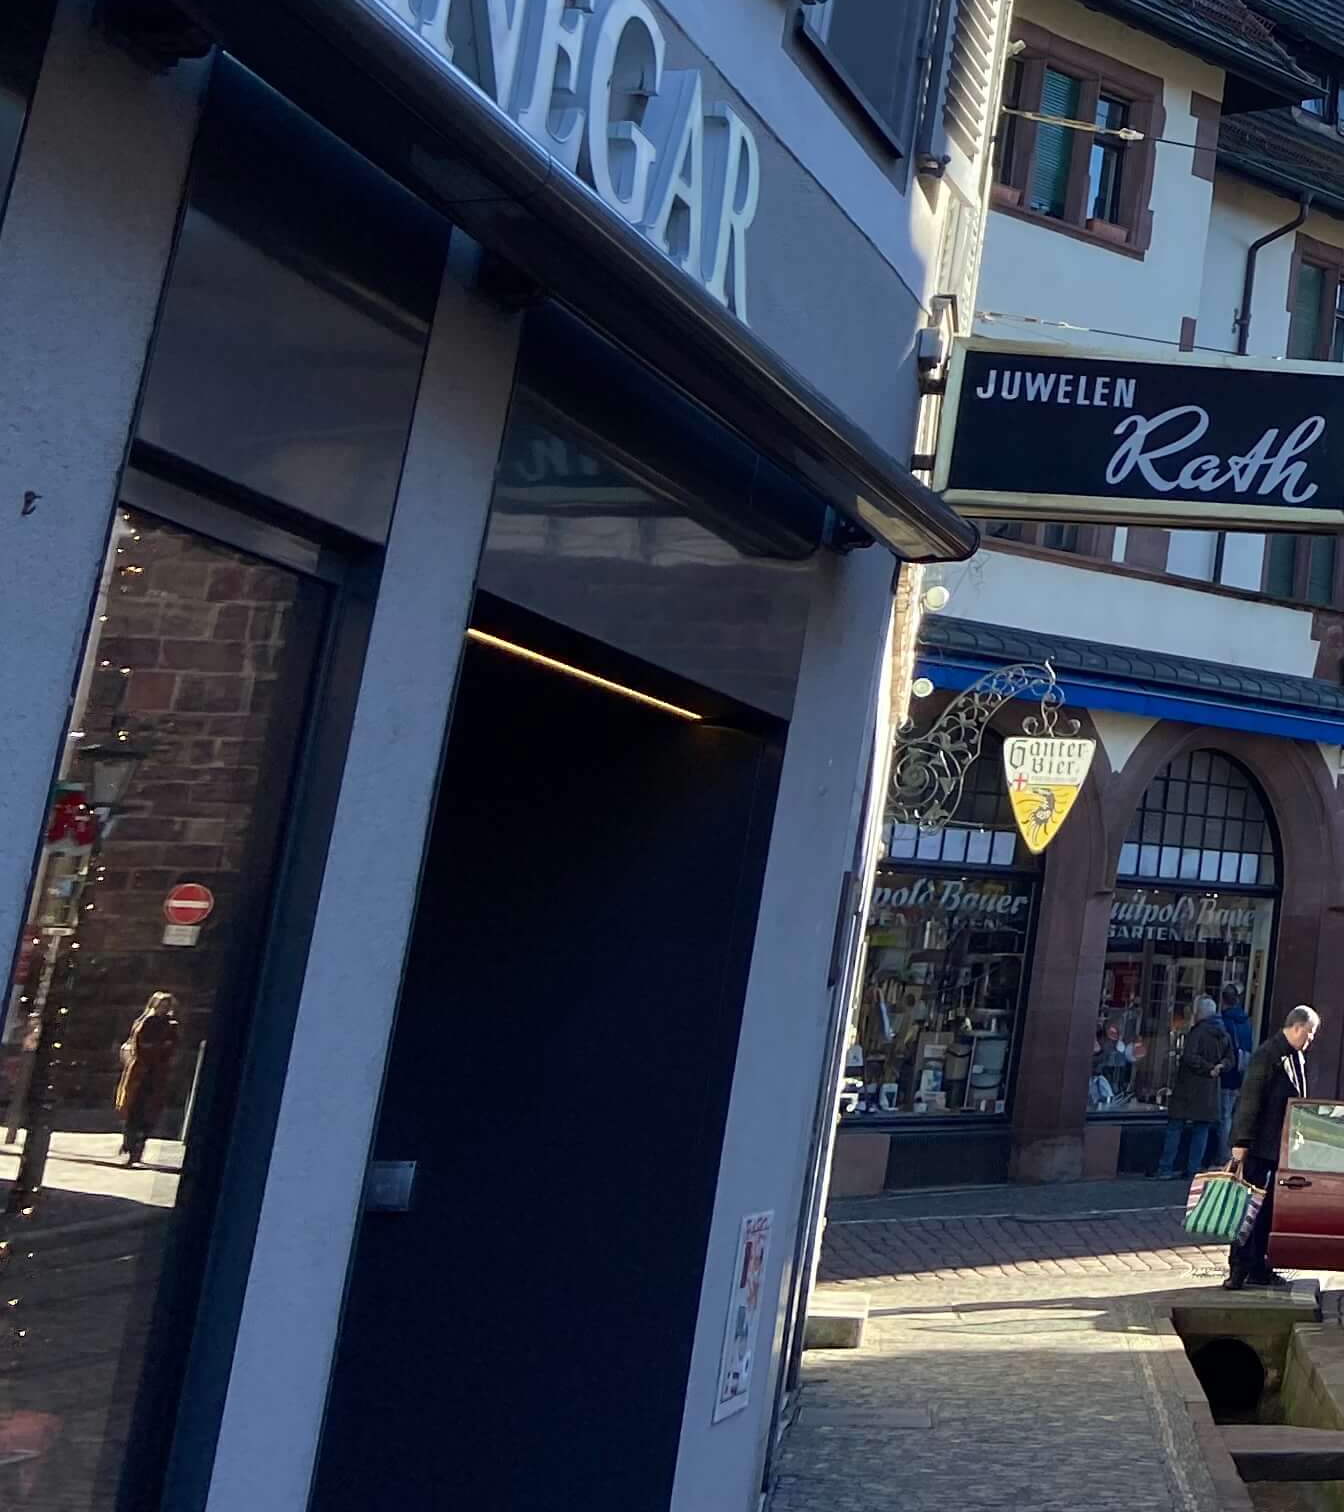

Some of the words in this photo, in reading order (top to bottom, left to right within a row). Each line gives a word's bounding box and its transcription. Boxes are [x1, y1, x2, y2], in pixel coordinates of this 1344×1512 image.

[976, 369, 1137, 409] JUWELEN
[1105, 405, 1326, 504] Rath
[940, 879, 1029, 916] Bauer
[1197, 897, 1256, 927] Baue
